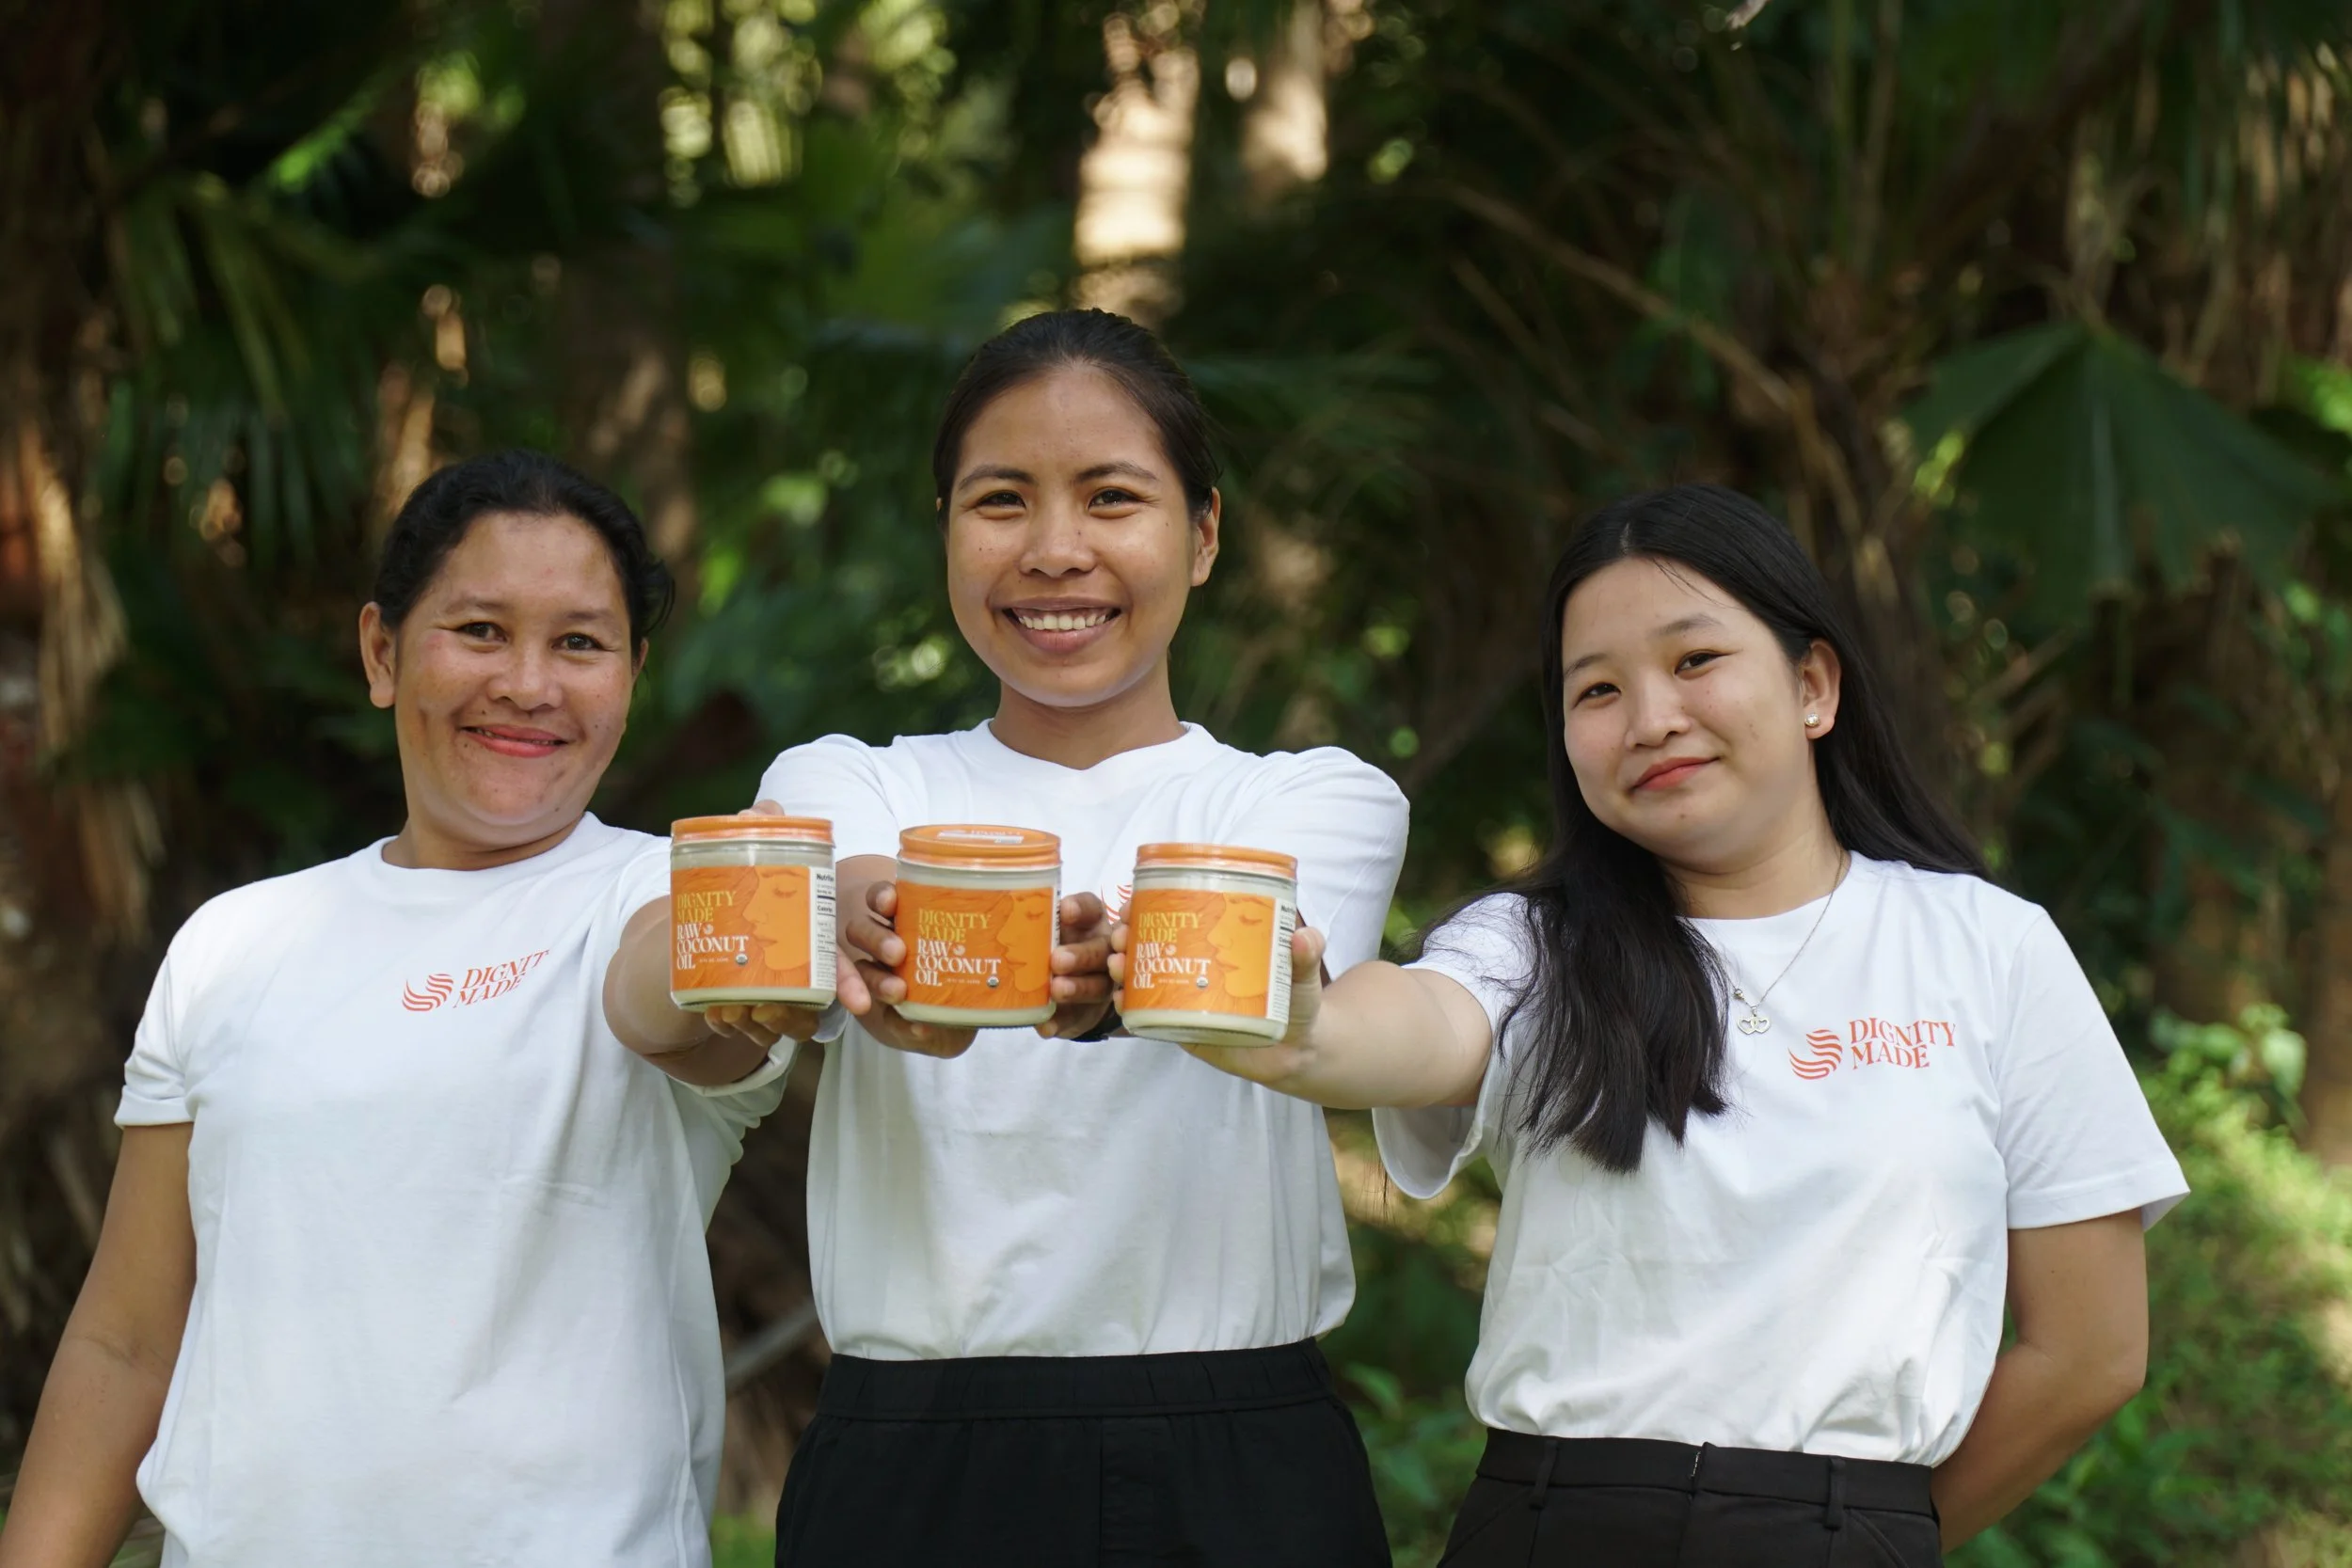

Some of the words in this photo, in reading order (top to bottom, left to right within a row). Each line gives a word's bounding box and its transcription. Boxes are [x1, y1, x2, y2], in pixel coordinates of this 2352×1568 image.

[677, 891, 737, 908] DIGNITY
[677, 907, 714, 924] MADE
[918, 909, 992, 929] DIGNITY
[1139, 911, 1201, 928] DIGNITY
[676, 922, 703, 940] RAW
[918, 924, 966, 943] MADE
[1137, 927, 1178, 943] MADE
[676, 935, 750, 954] COCONUT
[917, 936, 953, 958] RAW
[1136, 941, 1166, 959] RAW
[462, 949, 549, 989] DIGNIT
[676, 952, 696, 970] OIL
[916, 955, 1002, 974] COCONUT
[1135, 957, 1211, 975] COCONUT
[915, 968, 943, 987] OIL
[1133, 973, 1155, 989] OIL
[453, 972, 526, 1008] MADE
[1849, 1018, 1956, 1047] DIGNITY
[1851, 1041, 1931, 1069] MADE
